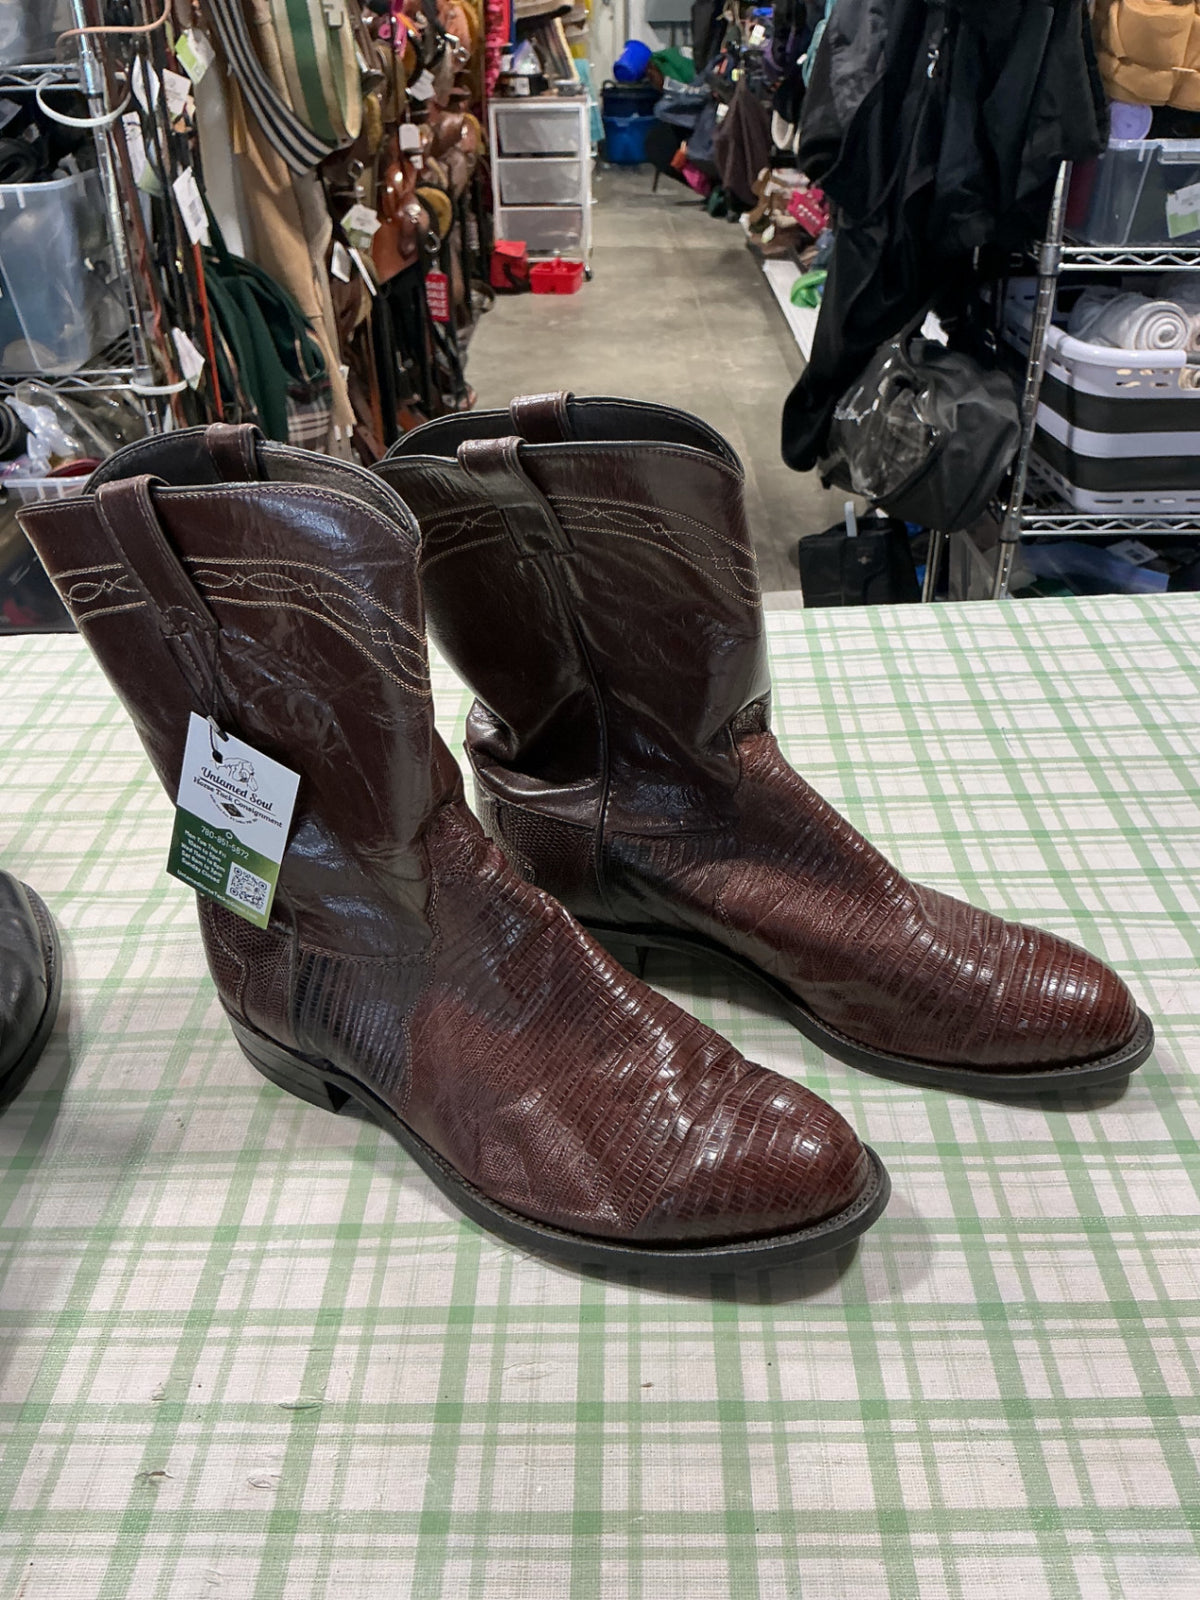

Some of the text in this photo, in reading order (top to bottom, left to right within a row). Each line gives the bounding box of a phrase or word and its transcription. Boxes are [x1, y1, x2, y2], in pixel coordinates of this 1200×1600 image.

[201, 766, 247, 797] Untamed
[249, 792, 273, 811] Soul
[193, 776, 214, 791] Horse
[216, 788, 232, 801] Tack
[233, 799, 283, 828] Consignment
[181, 843, 193, 852] Wed
[185, 830, 196, 840] Mon
[197, 837, 207, 846] Tue
[208, 844, 218, 853] Thu
[181, 857, 220, 883] Sunday Closed
